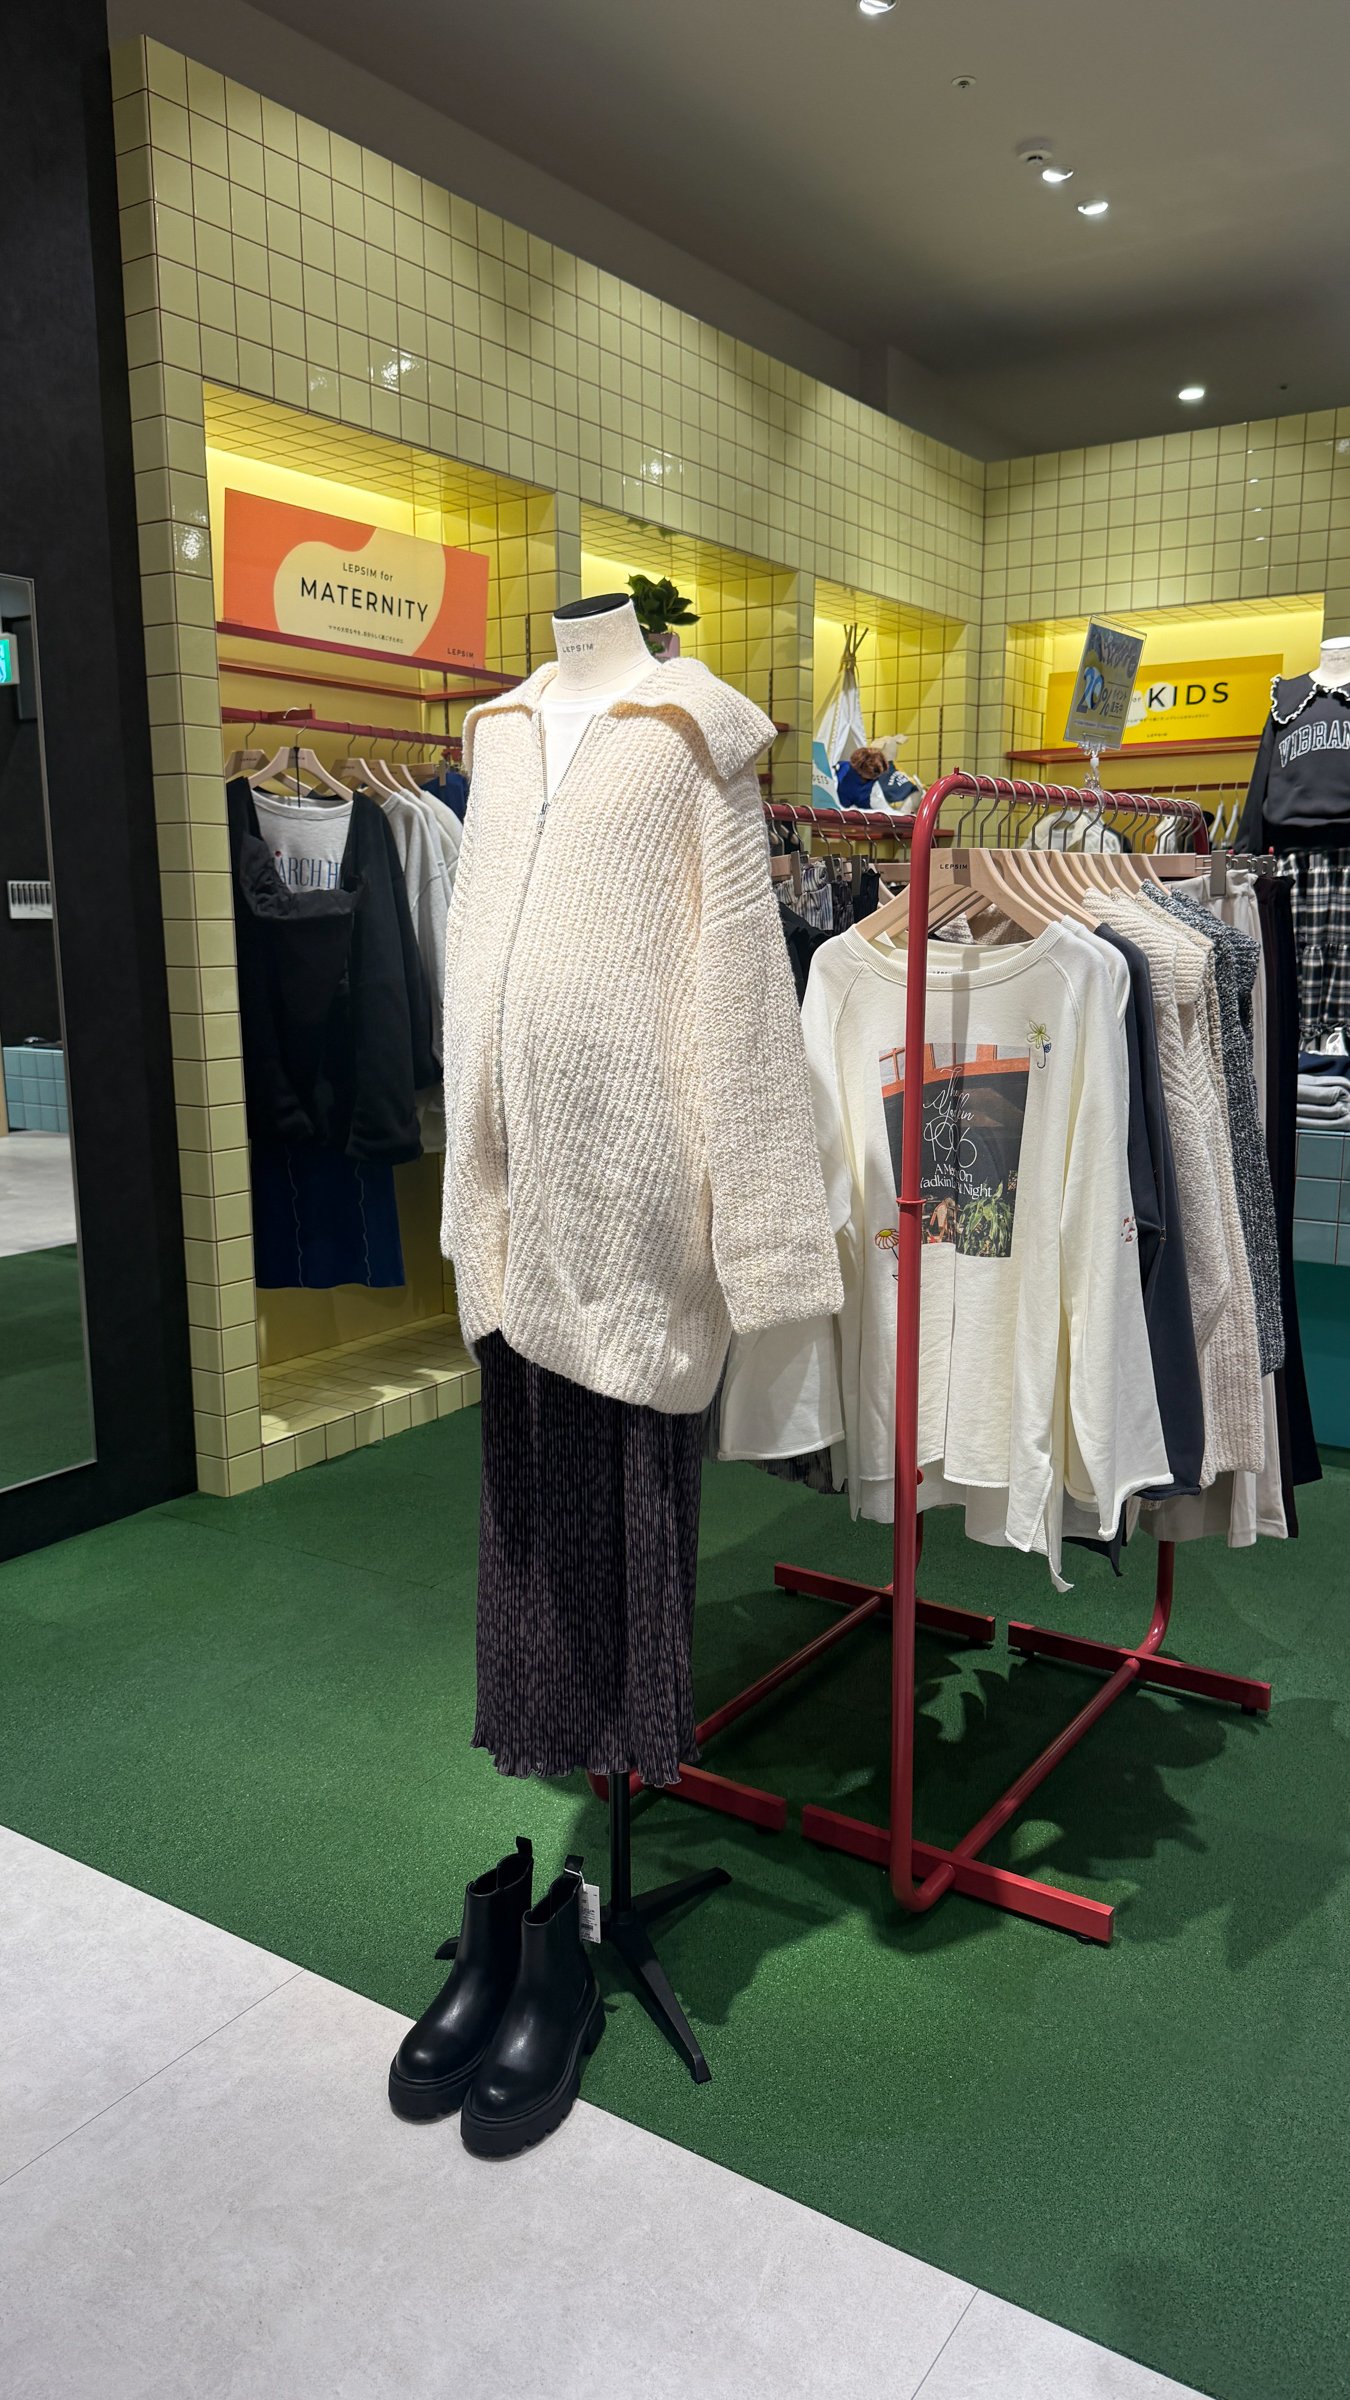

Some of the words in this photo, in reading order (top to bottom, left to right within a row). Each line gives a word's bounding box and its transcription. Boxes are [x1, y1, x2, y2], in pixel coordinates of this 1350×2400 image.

[342, 562, 377, 579] LEPSIM
[380, 570, 394, 582] for
[300, 576, 428, 622] MATERNITY
[447, 647, 474, 658] LEPSIM
[562, 643, 594, 653] LEPSIM
[1148, 682, 1229, 709] KIDS
[959, 1169, 973, 1183] On
[963, 1182, 993, 1200] Night
